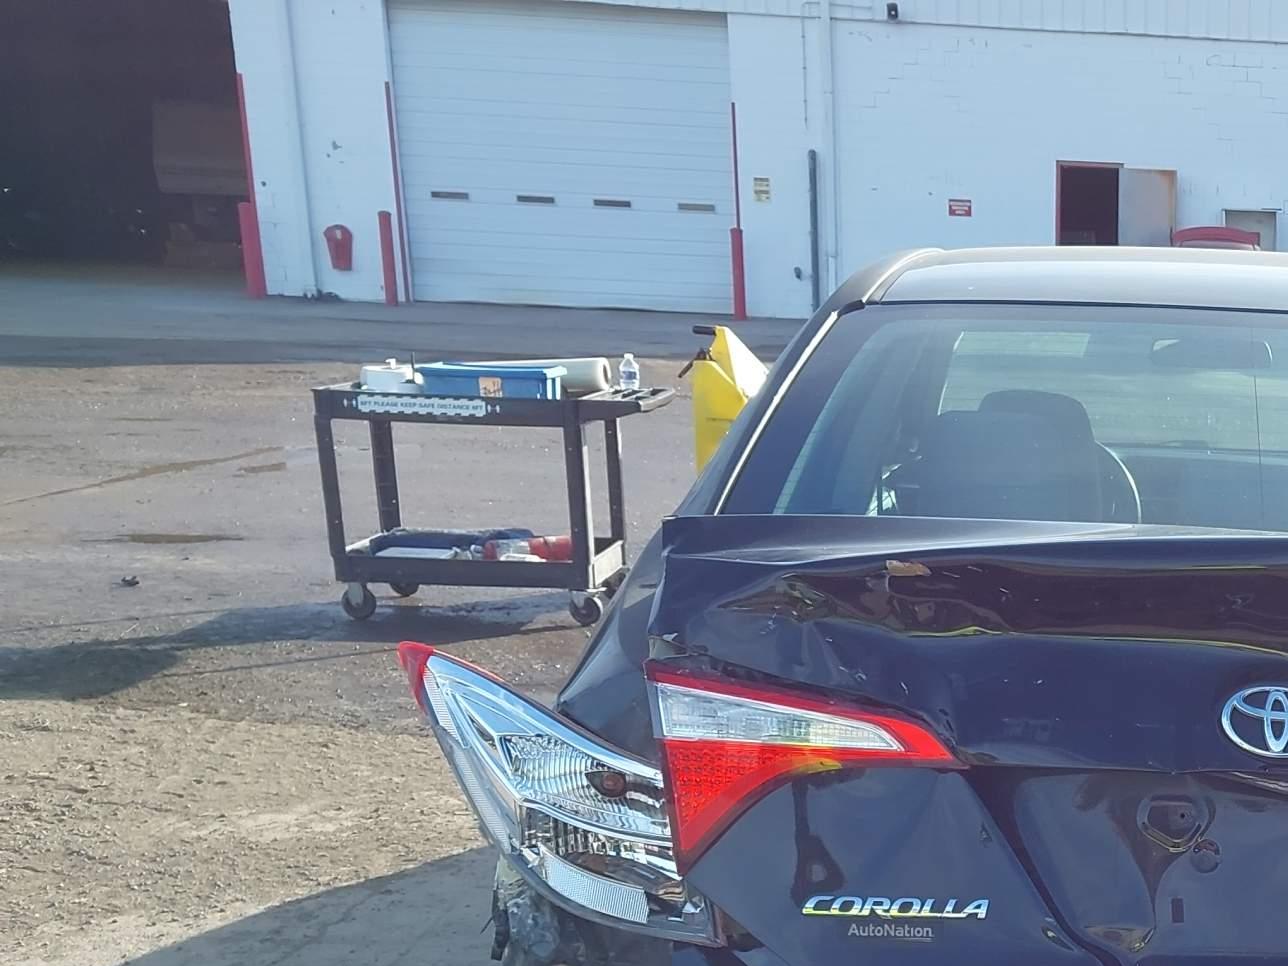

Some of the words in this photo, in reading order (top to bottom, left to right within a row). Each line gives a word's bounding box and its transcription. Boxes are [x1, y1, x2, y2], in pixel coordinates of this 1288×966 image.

[437, 403, 470, 411] DISTANCE
[802, 895, 989, 919] COROLLA
[848, 923, 933, 937] AutoNation
